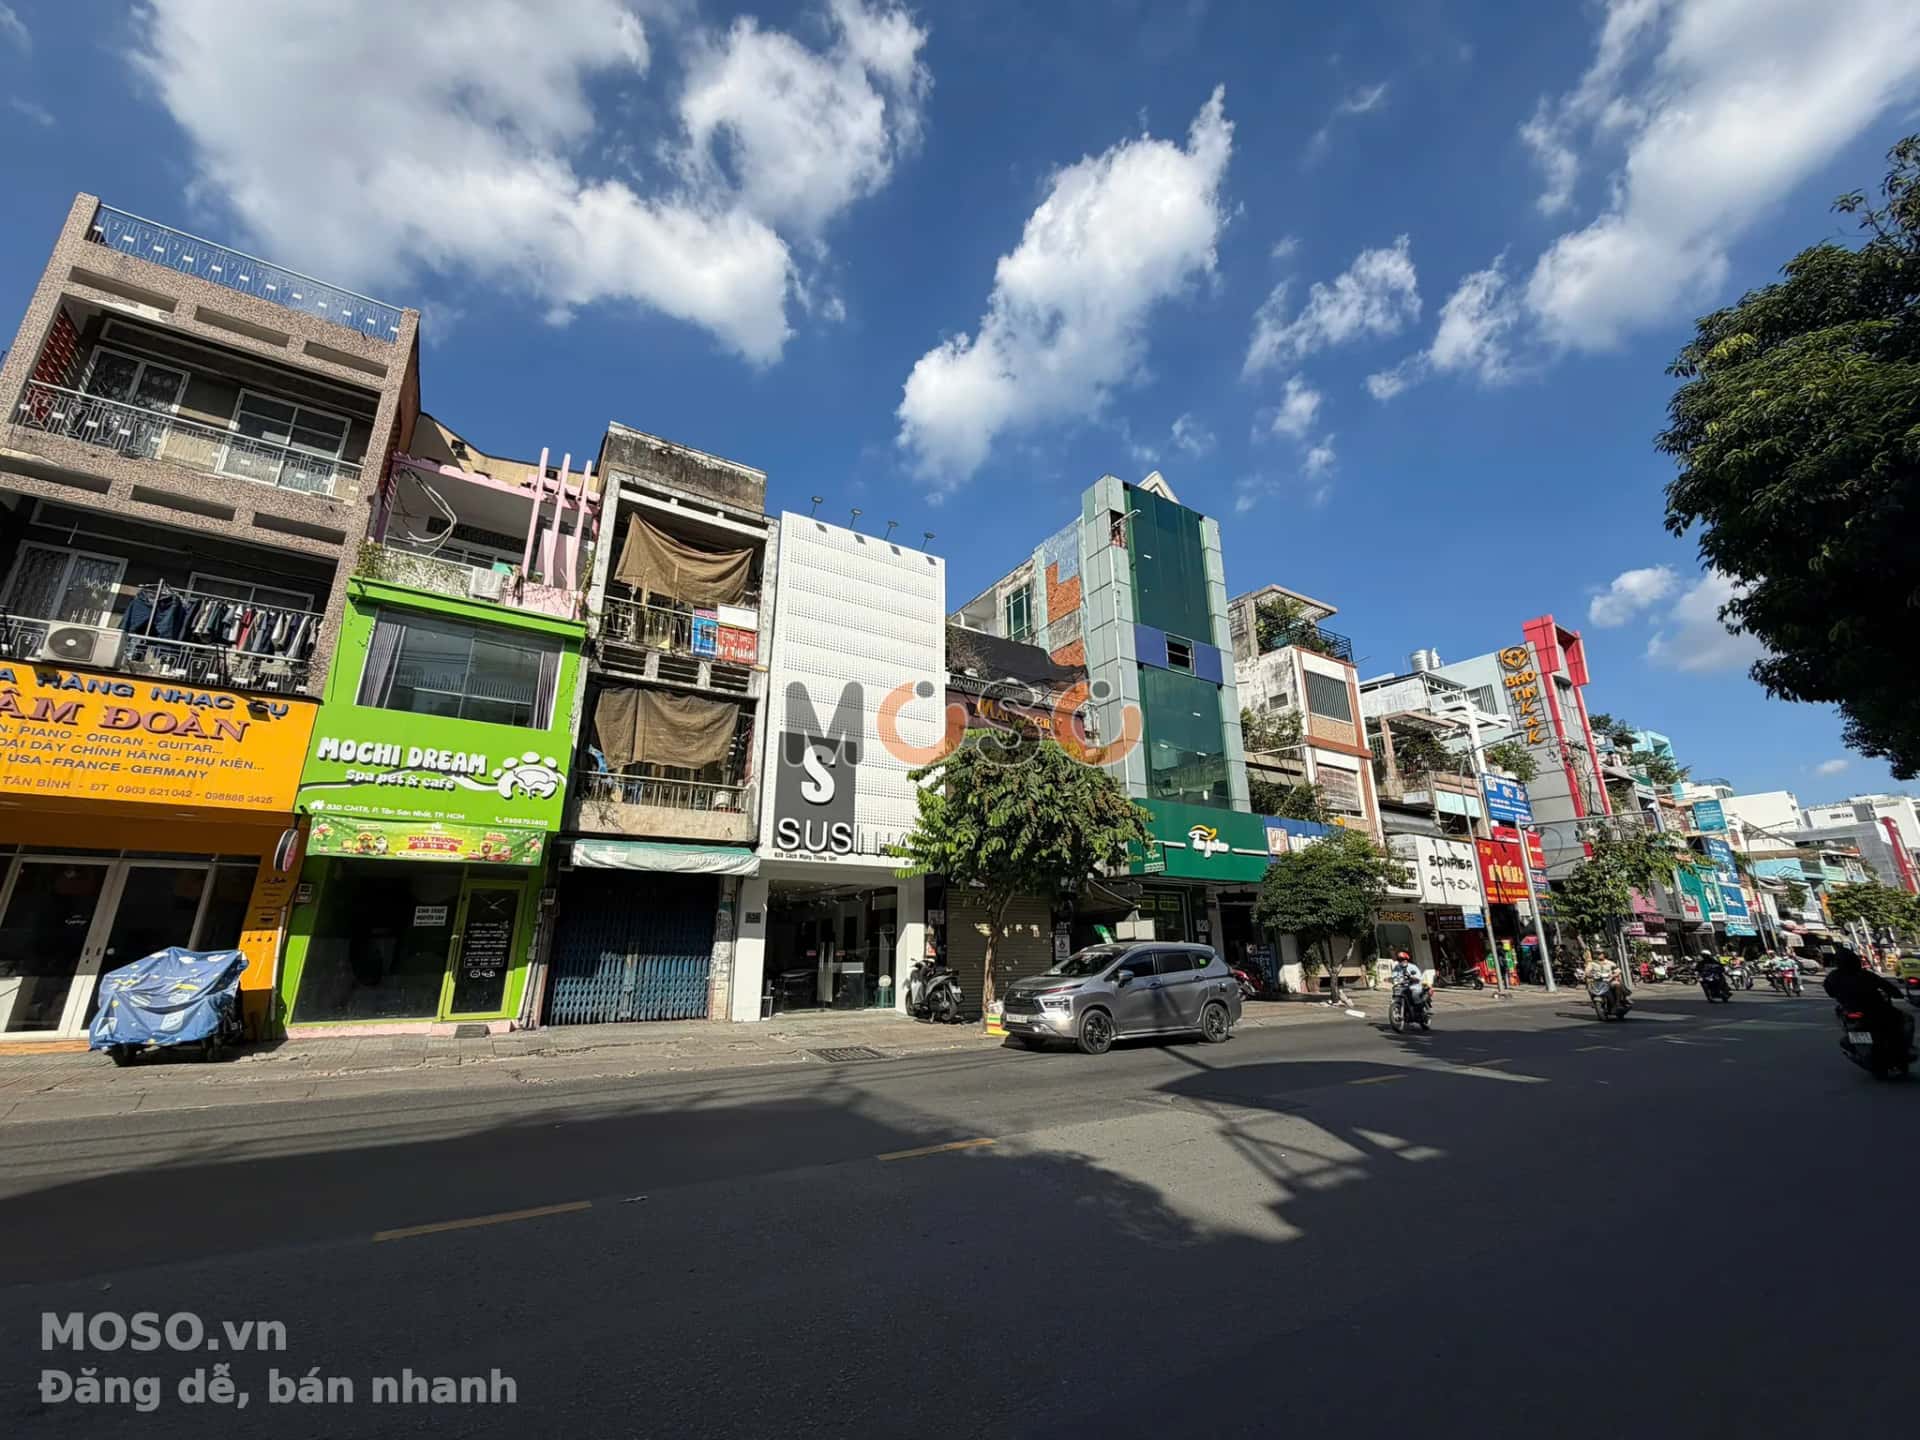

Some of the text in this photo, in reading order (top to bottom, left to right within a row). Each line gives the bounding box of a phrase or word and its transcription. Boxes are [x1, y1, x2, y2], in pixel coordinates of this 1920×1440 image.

[37, 671, 135, 698] HÀNG
[151, 687, 235, 711] NHẠC
[247, 699, 289, 720] CỤ
[19, 726, 72, 739] PIANO
[86, 733, 144, 746] ORGAN
[98, 704, 250, 743] ĐOÀN
[8, 754, 41, 764] USA
[52, 757, 120, 772] FRANCE
[131, 765, 208, 779] GERMANY
[70, 744, 122, 758] CHÍNH
[185, 756, 215, 768] PHỤ
[317, 737, 488, 775] MOCHI DREAM
[346, 769, 375, 785] Spa
[376, 774, 405, 788] pet
